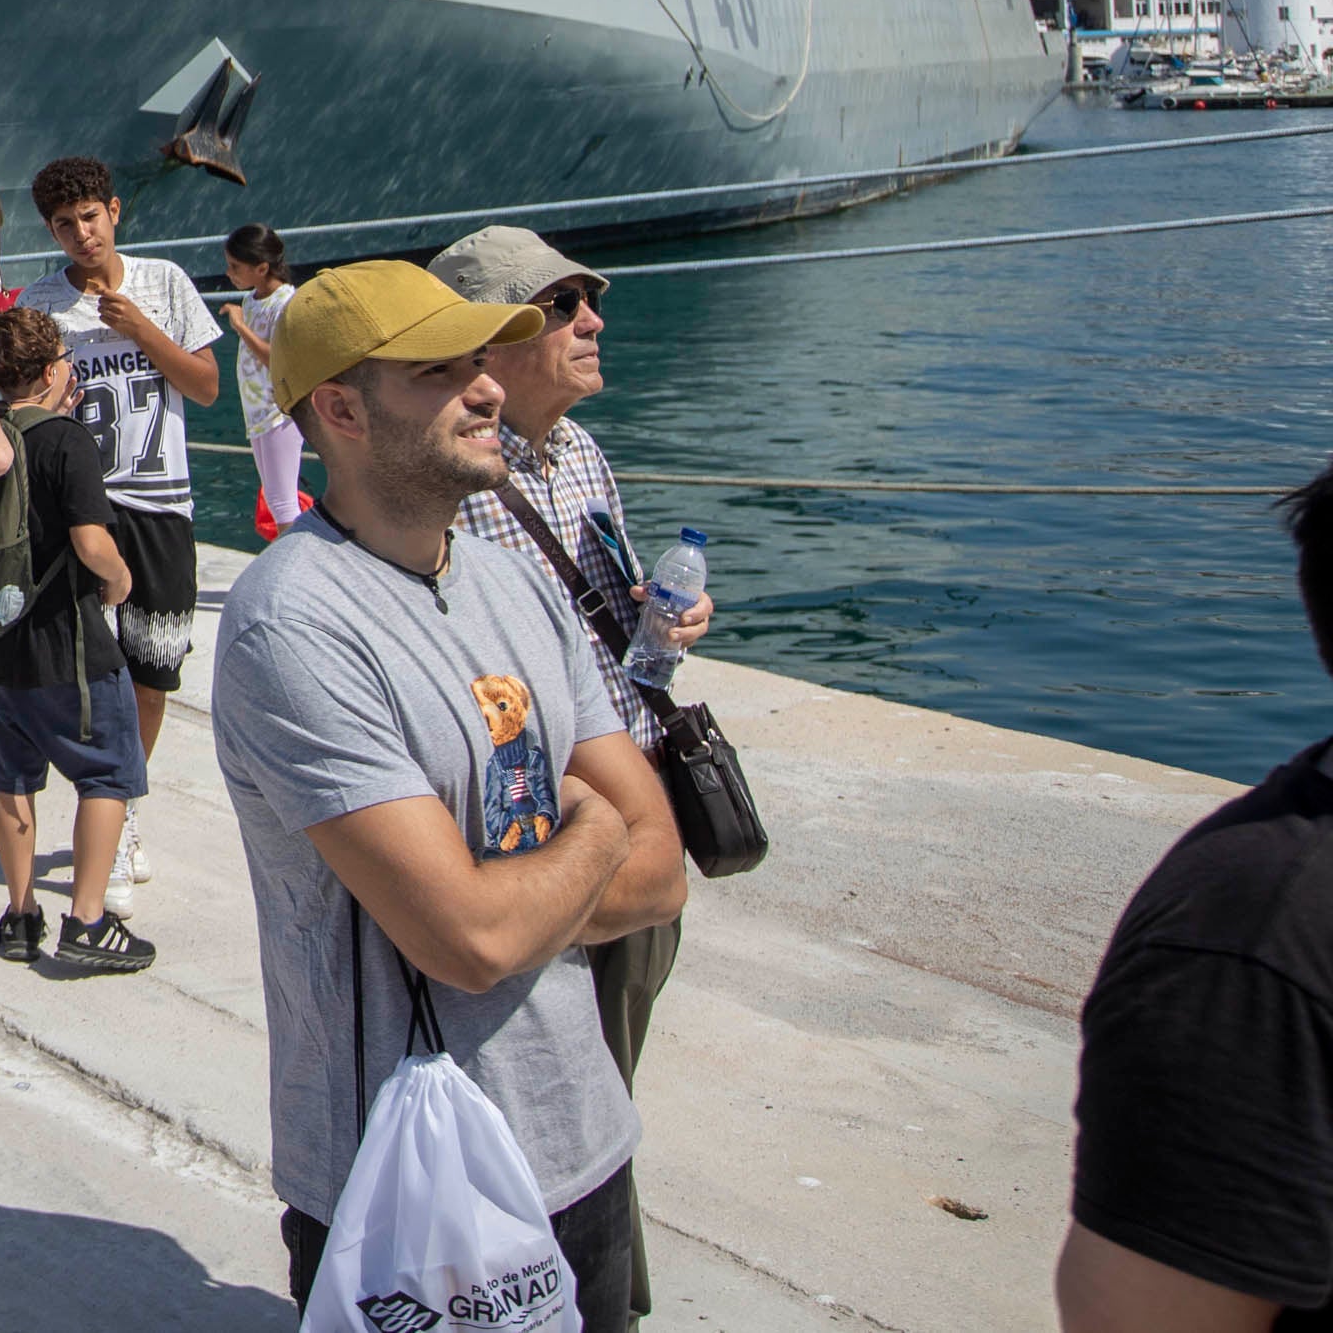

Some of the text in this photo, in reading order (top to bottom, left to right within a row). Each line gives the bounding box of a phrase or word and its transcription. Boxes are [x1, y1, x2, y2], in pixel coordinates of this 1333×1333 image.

[72, 372, 169, 478] 87
[448, 1269, 558, 1323] GRANAD
[502, 1272, 519, 1284] de
[521, 1254, 554, 1278] Motril
